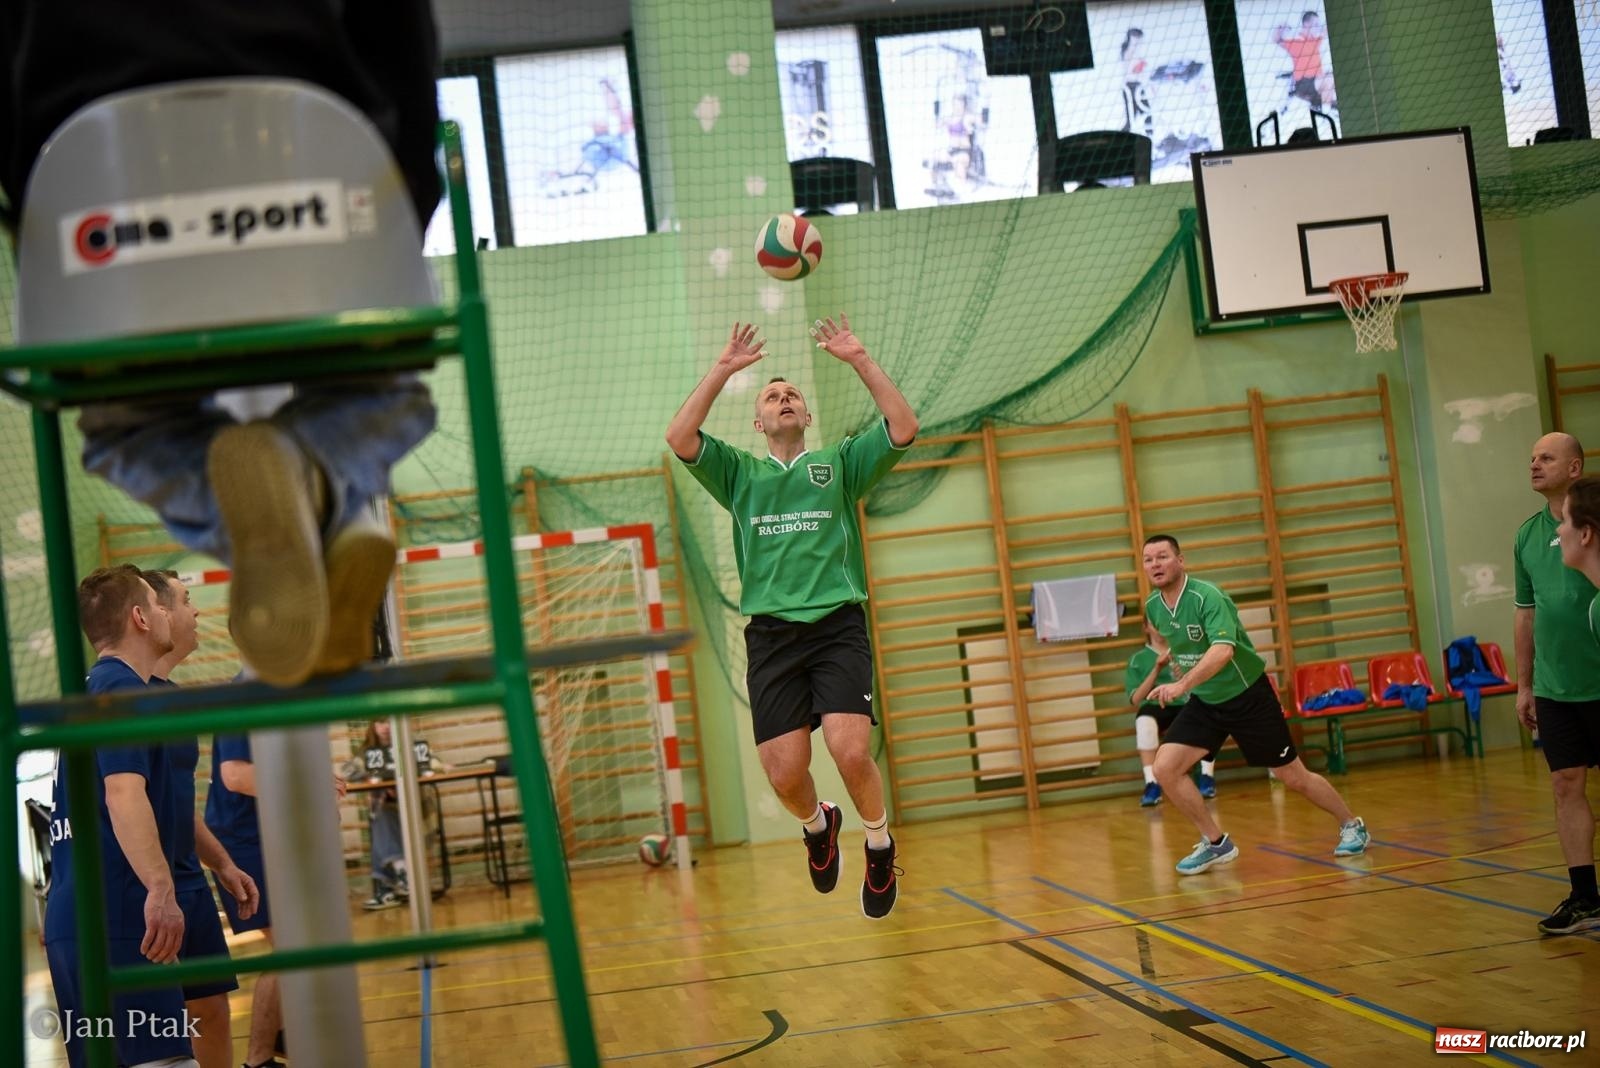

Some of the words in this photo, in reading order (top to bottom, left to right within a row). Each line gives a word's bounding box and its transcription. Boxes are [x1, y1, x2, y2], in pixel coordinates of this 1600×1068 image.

[208, 195, 328, 244] sport
[758, 520, 819, 536] RACIBÓRZ
[367, 749, 384, 769] 23
[414, 744, 429, 762] 12
